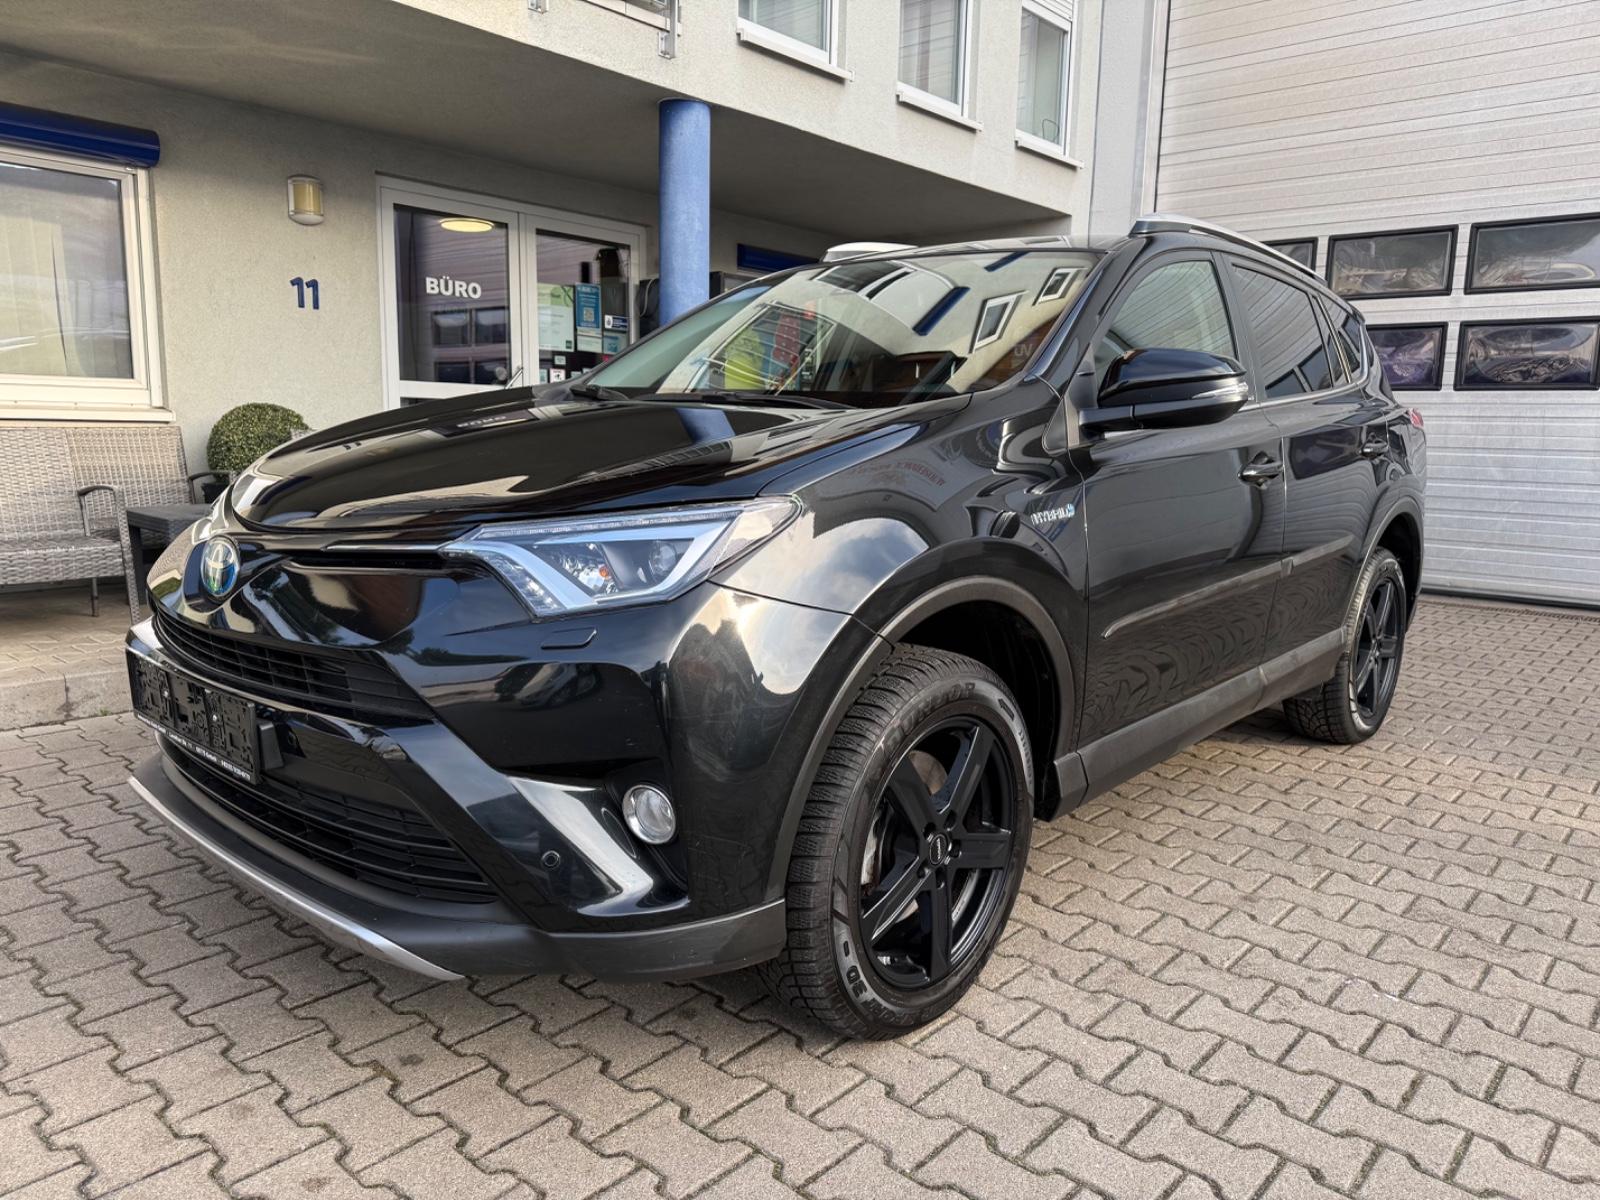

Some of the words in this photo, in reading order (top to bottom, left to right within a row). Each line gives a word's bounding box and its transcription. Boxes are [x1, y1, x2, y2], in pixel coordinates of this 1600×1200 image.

[290, 277, 320, 310] 11
[425, 275, 482, 299] BÜRO
[1030, 507, 1070, 525] HYBRID
